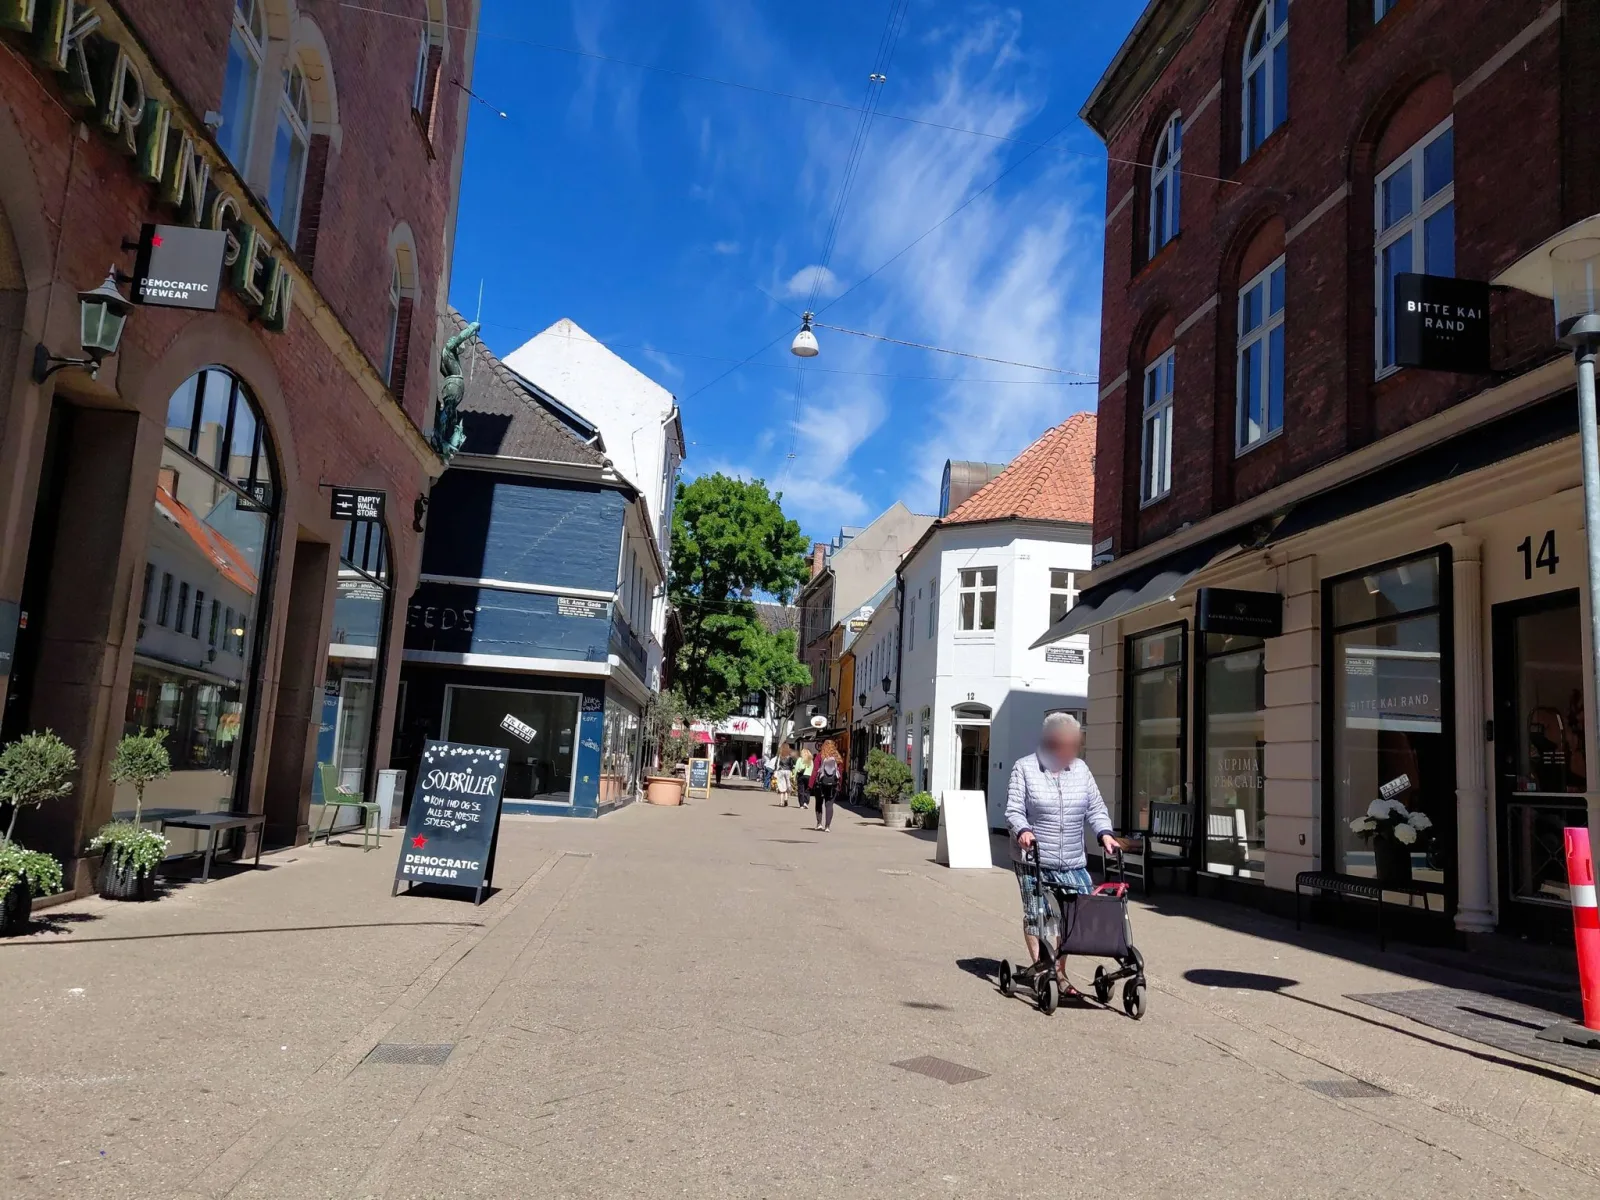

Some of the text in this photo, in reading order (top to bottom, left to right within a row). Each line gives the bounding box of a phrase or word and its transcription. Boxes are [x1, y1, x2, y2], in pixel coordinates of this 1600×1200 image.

[141, 278, 208, 292] DEMOCRATIC
[139, 287, 189, 299] EYEWEAR
[1407, 300, 1481, 319] BITTE KAI
[1425, 317, 1465, 331] RAND
[357, 495, 380, 504] EMPTY
[357, 502, 376, 511] WALL
[356, 509, 378, 518] STORE
[1517, 530, 1559, 580] 14
[967, 692, 975, 701] 12
[1351, 694, 1429, 712] BITTE KAI RAND
[517, 723, 535, 737] LEJE
[1218, 758, 1259, 771] SUPIMA
[421, 769, 497, 796] SOLBRILLER
[1214, 775, 1263, 789] PERCALE
[430, 795, 445, 807] KOM
[460, 800, 470, 811] OG
[471, 801, 482, 811] SE
[427, 807, 443, 818] ALLE
[443, 809, 453, 818] DE
[424, 817, 451, 828] STYLES
[405, 854, 479, 870] DEMOCRATIC
[403, 865, 458, 879] EYEWEAR
